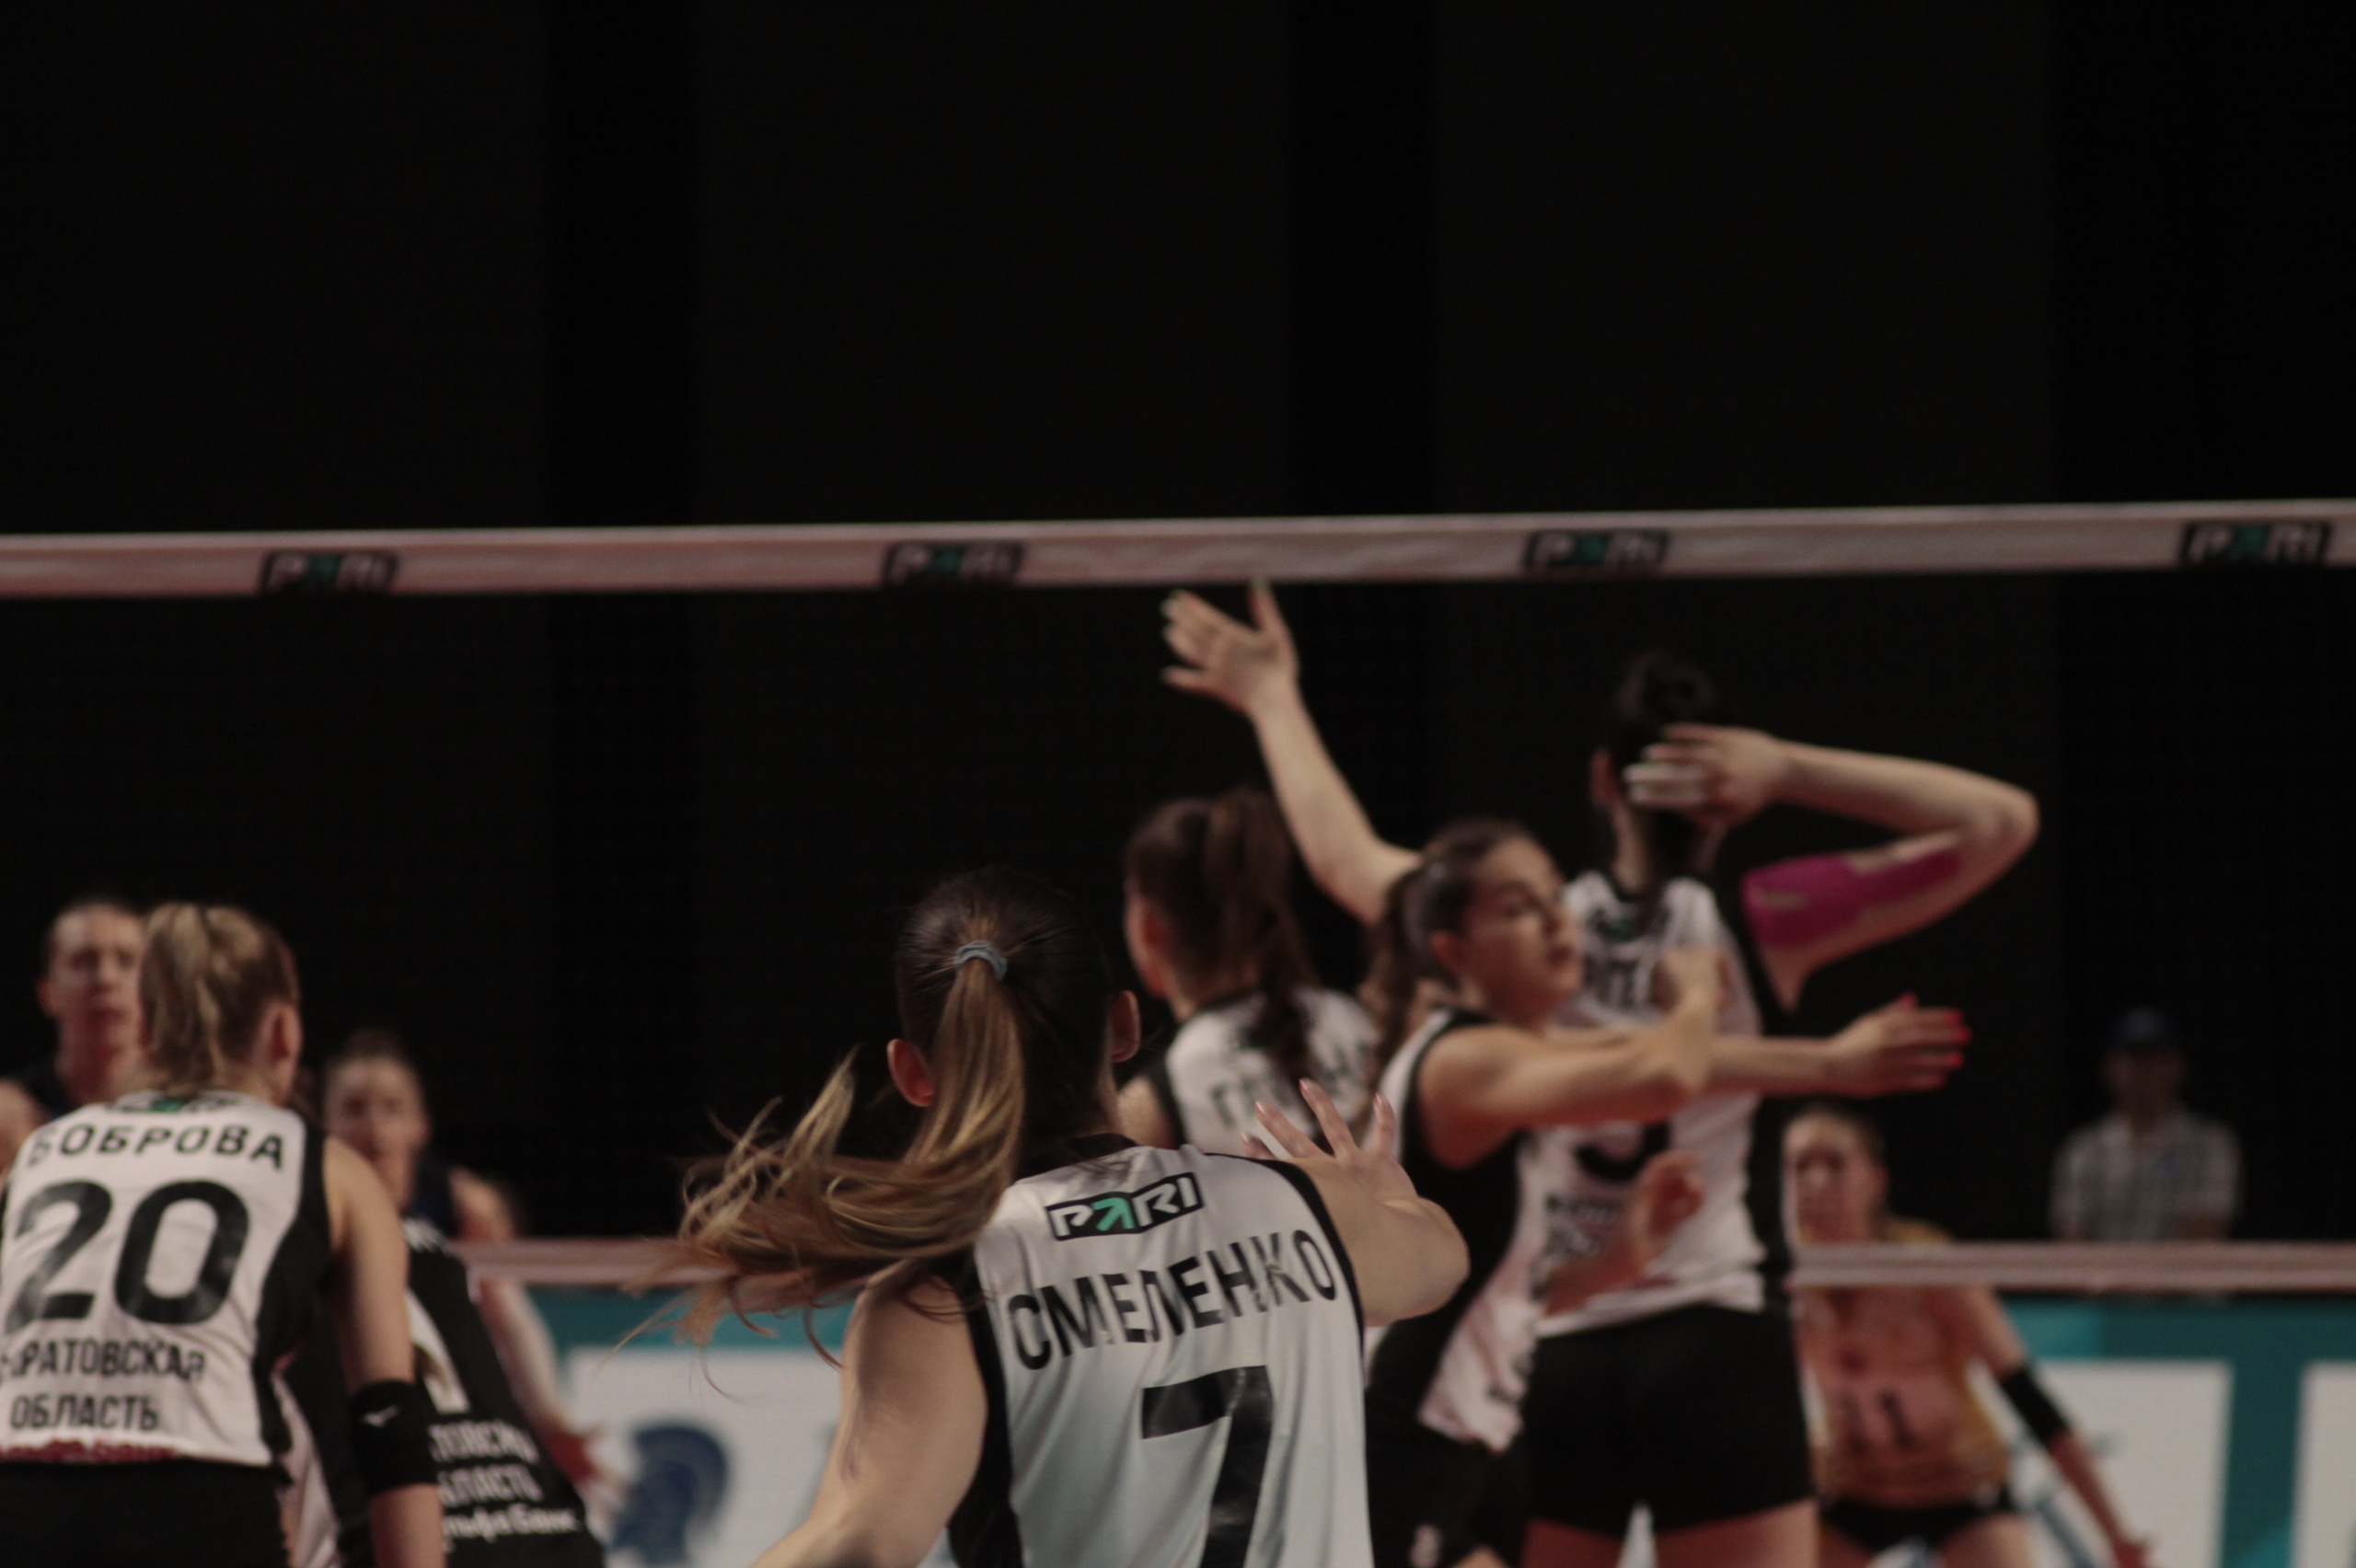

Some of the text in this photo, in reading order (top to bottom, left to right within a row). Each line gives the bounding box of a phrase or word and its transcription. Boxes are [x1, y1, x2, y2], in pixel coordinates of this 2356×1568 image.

[28, 1123, 284, 1170] БОБРОВА
[1048, 1176, 1199, 1238] PARI
[5, 1180, 249, 1333] 20
[1009, 1229, 1336, 1370] СМЕЛЕНКО
[0, 1338, 206, 1381] РАТОВСКАЯ
[11, 1393, 158, 1431] ОБЛАСТЬ
[437, 1464, 546, 1509] БЛАСТЬ
[1141, 1366, 1275, 1568] 7
